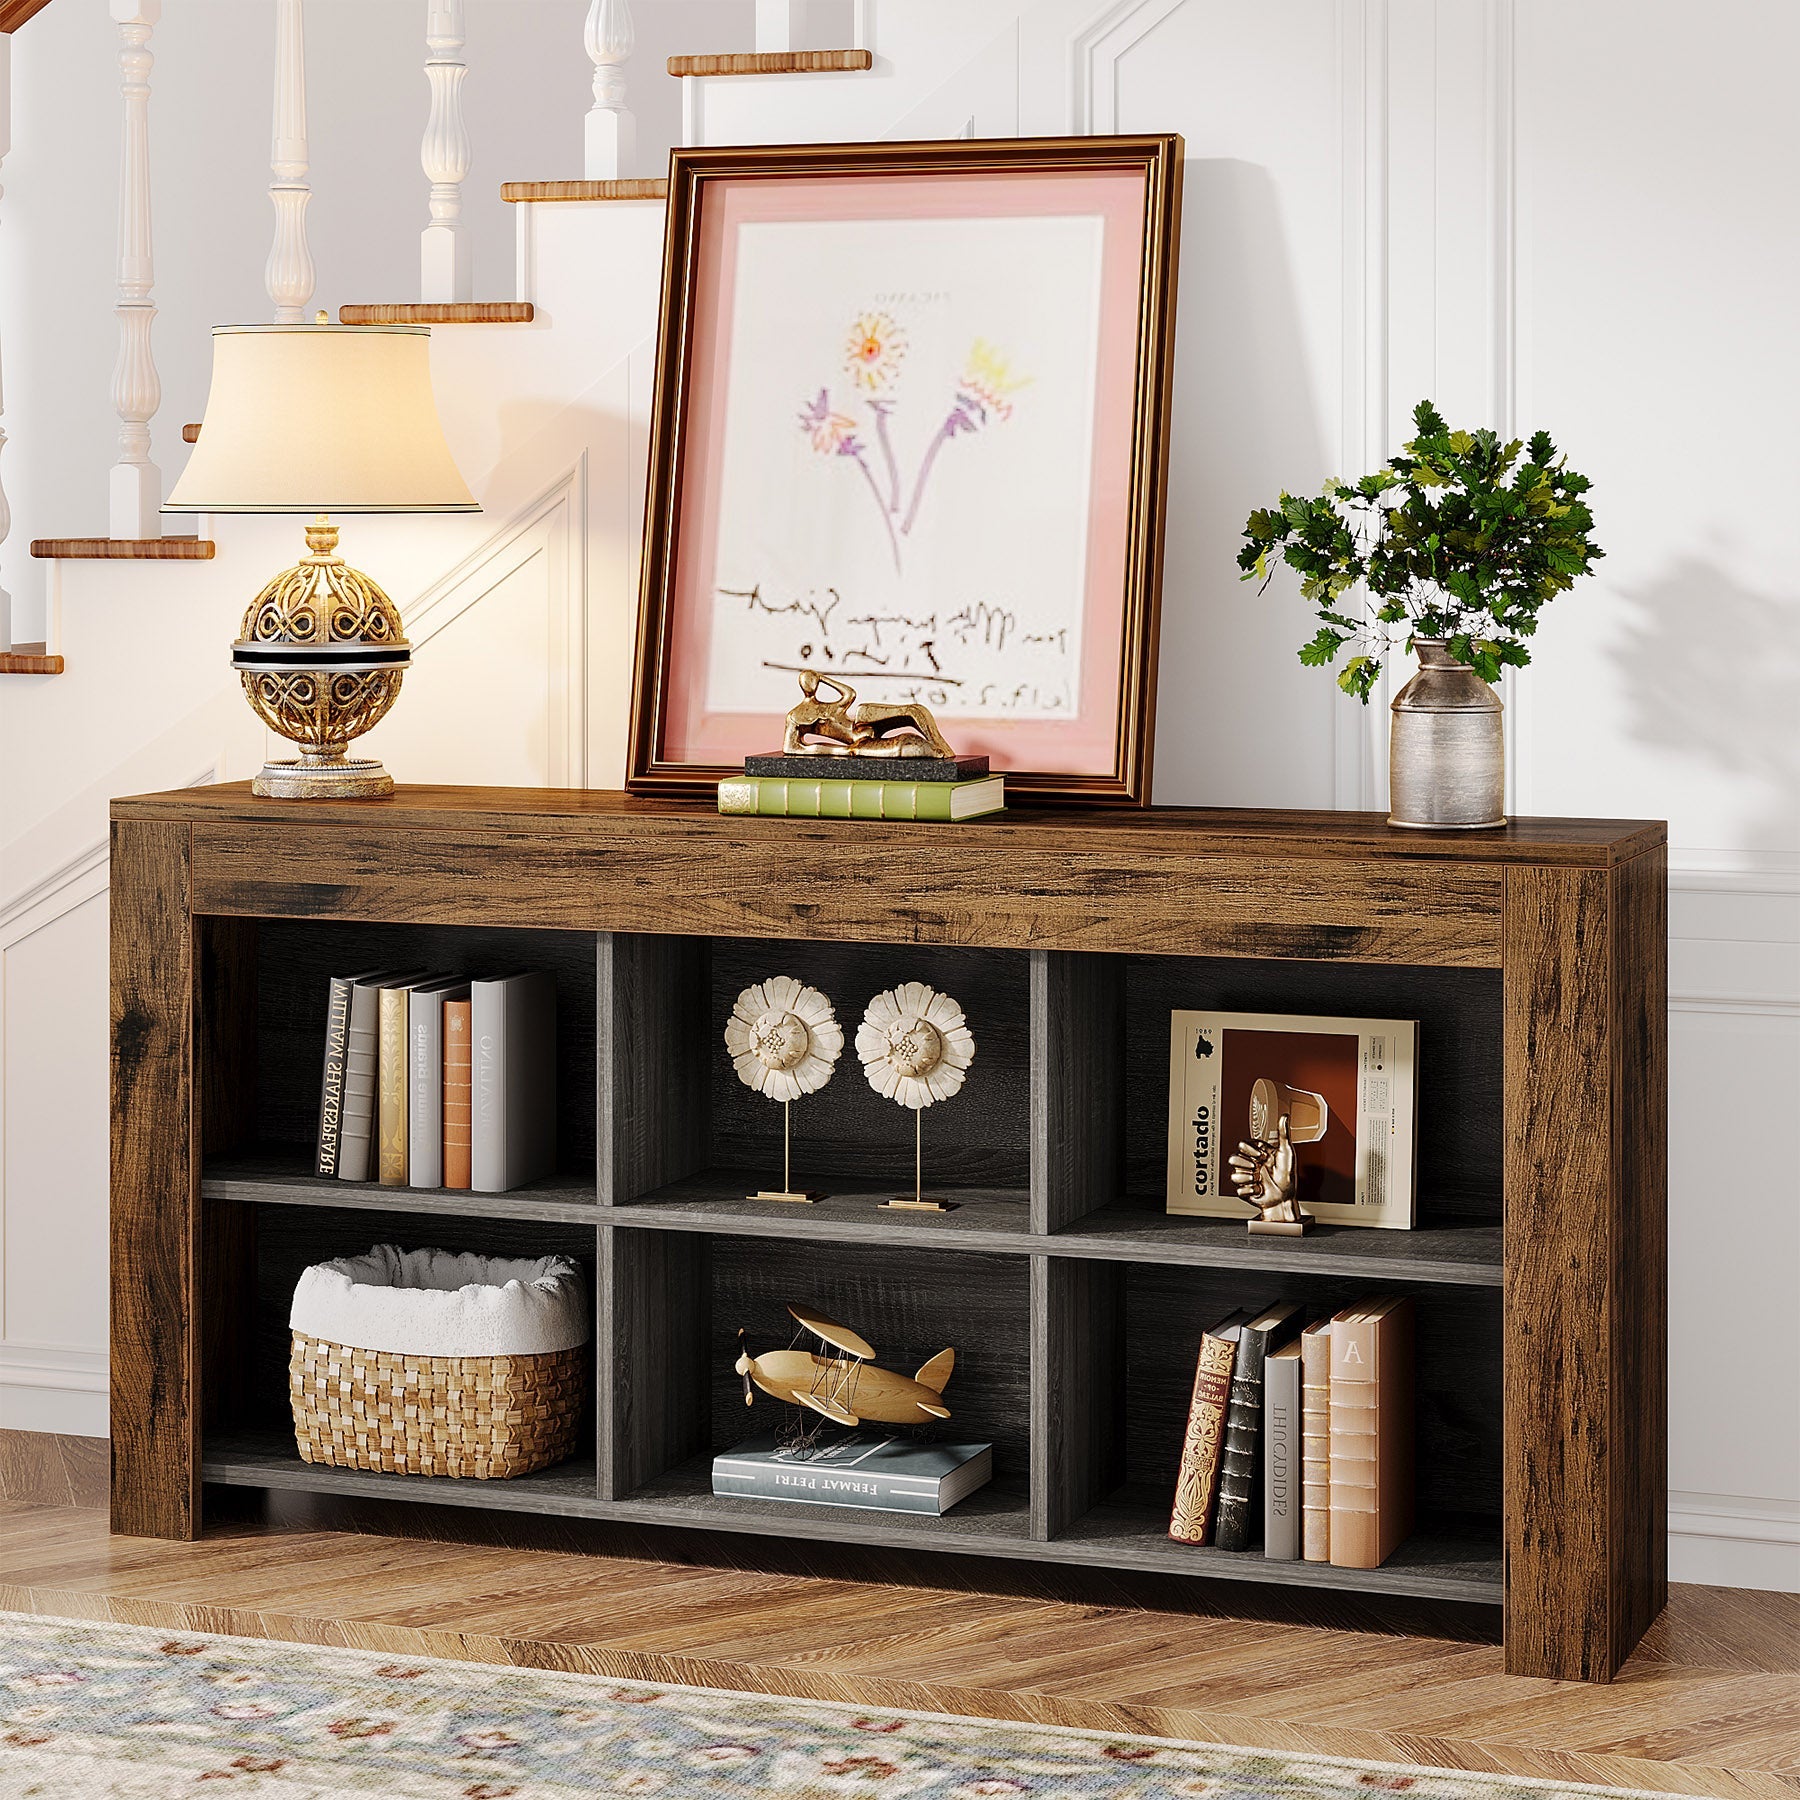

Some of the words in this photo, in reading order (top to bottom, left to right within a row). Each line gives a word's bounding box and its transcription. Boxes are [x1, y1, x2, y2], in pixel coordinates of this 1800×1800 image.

[1192, 1105, 1209, 1196] cortado
[1341, 1340, 1365, 1365] A
[775, 1474, 817, 1490] PETRI
[821, 1479, 878, 1496] FERMAT
